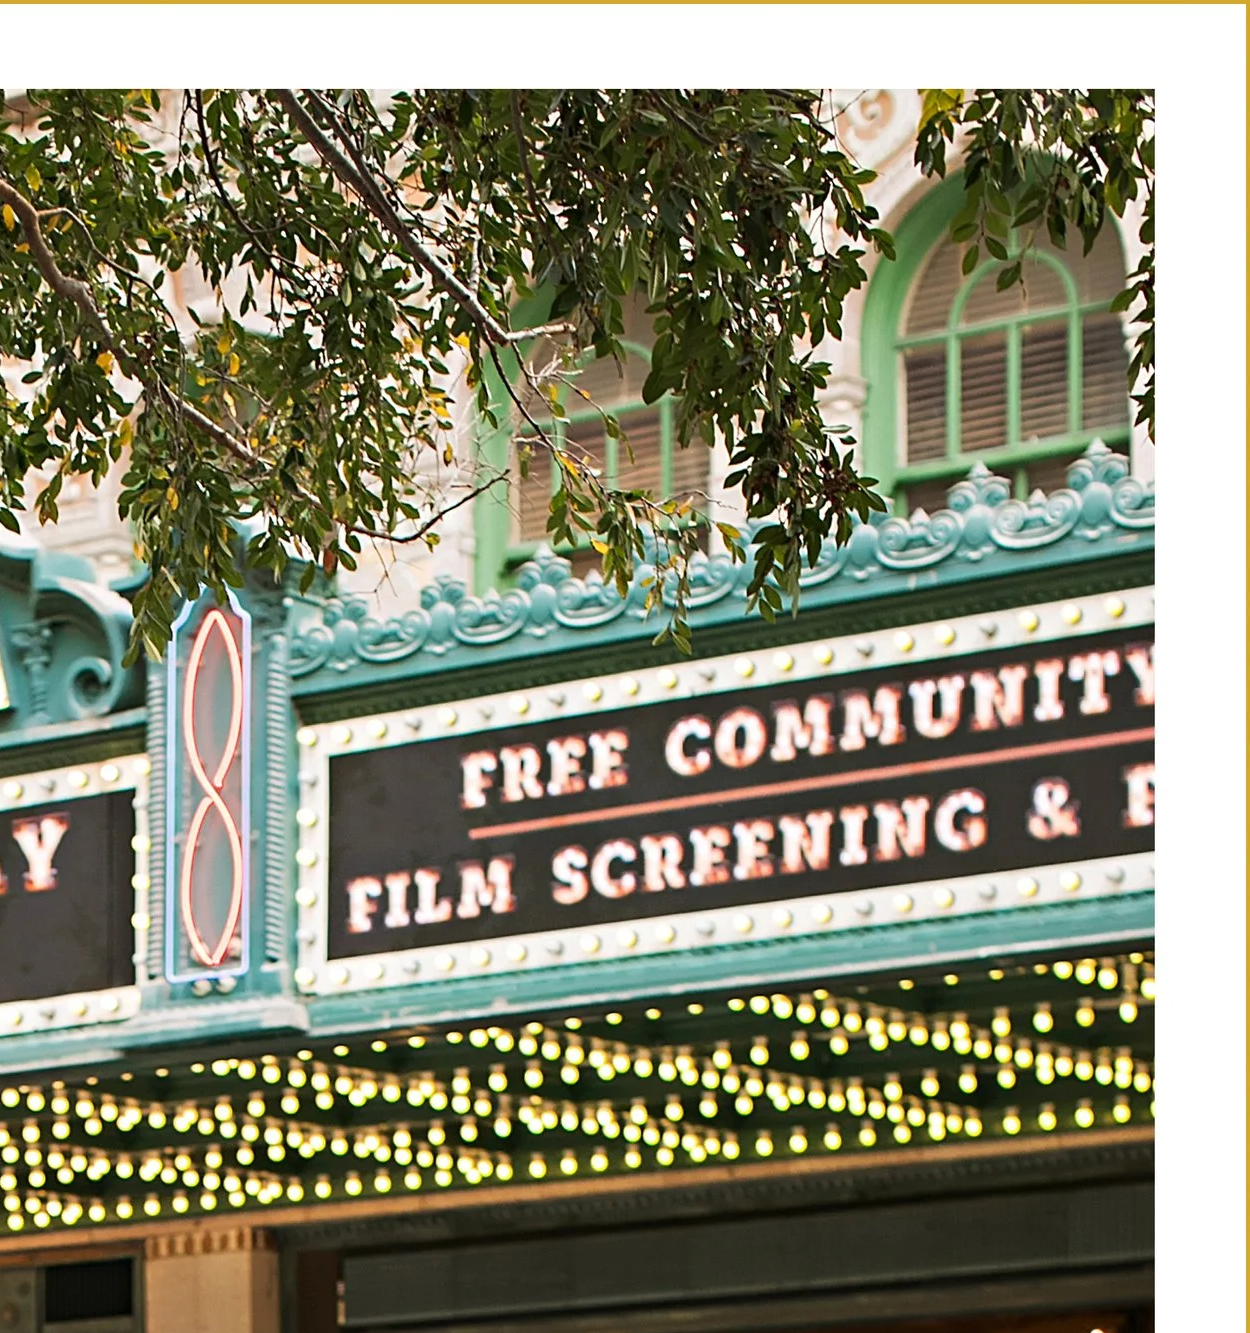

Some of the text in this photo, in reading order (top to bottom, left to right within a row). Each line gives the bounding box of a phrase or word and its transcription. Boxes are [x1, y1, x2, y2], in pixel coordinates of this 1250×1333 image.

[459, 645, 1155, 809] FREE COMMUNITY
[346, 855, 516, 934] FILM
[552, 788, 987, 905] SCREENING
[1027, 779, 1081, 840] &
